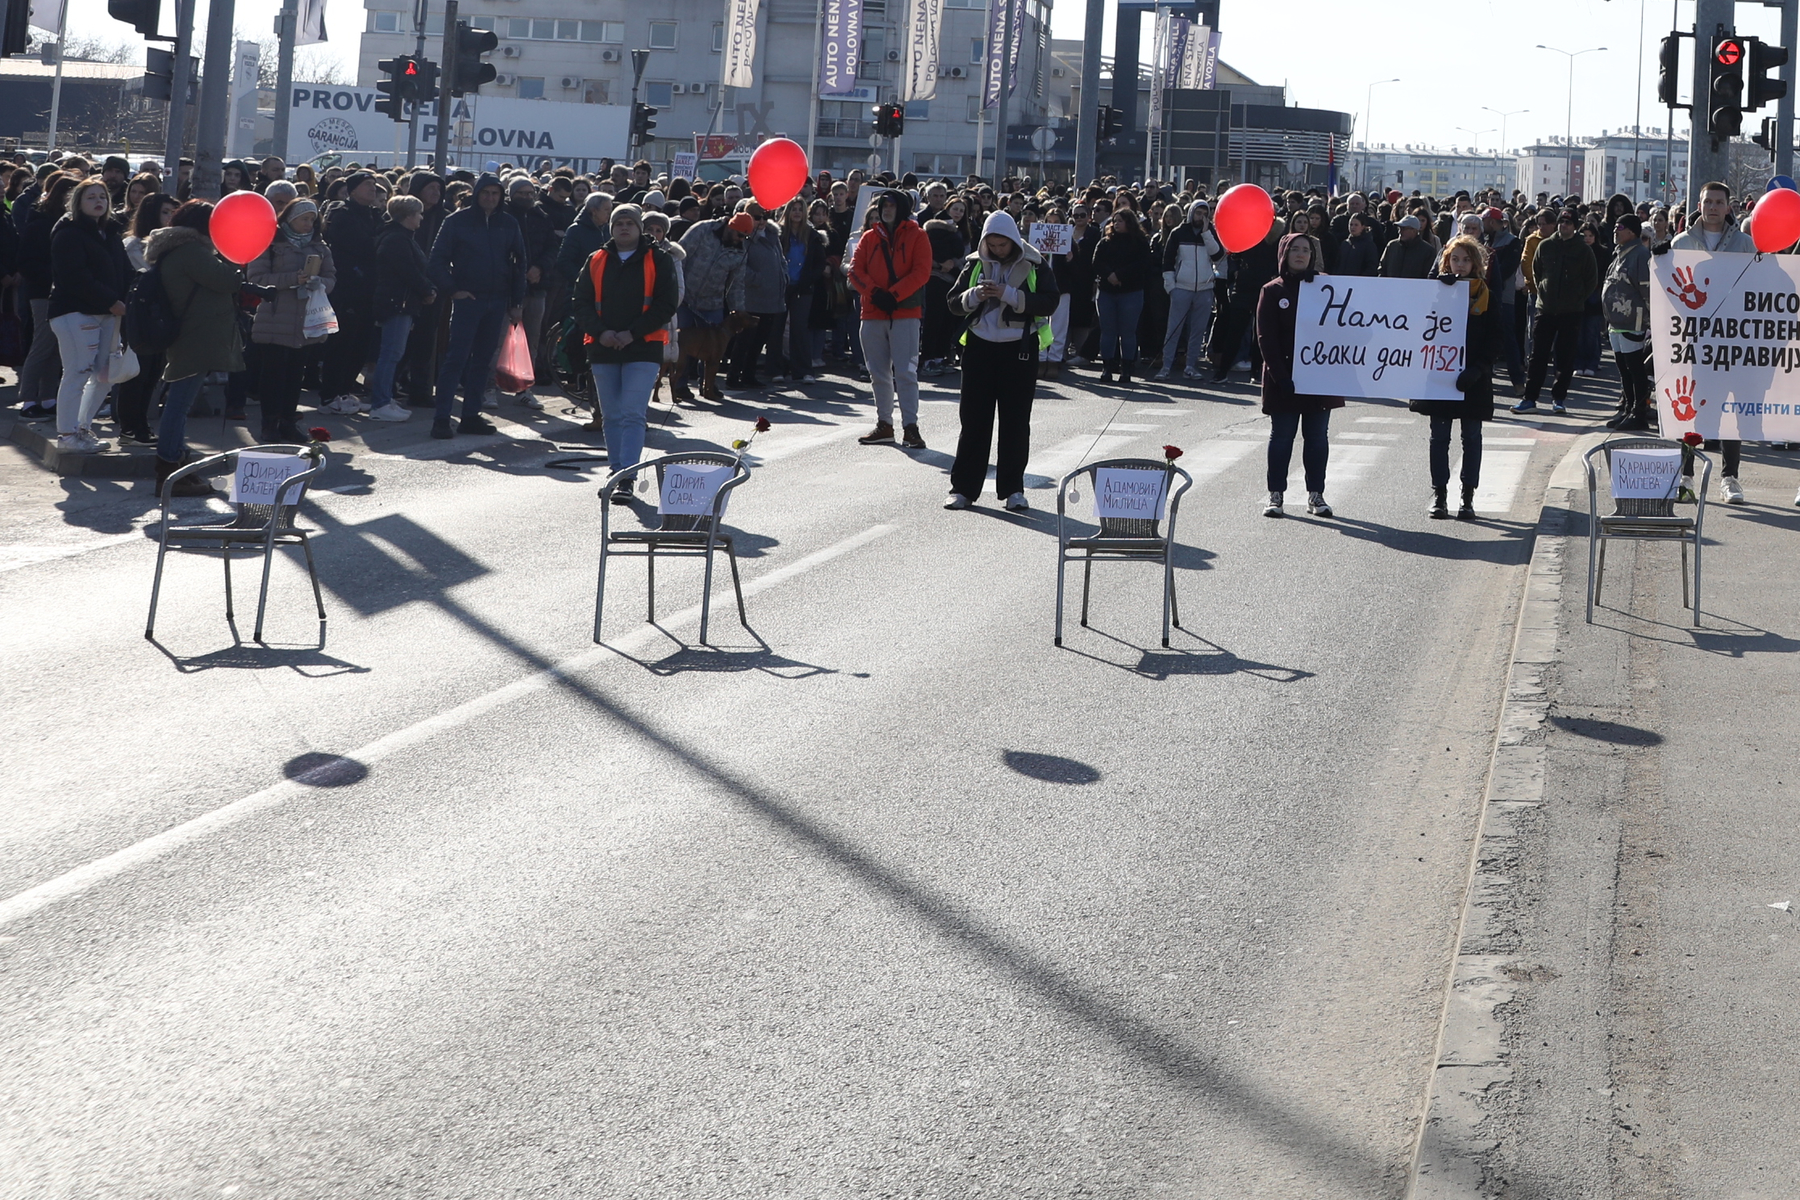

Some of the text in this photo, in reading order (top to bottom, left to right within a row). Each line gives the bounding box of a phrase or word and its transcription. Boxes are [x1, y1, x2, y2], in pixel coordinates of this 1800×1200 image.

[914, 1, 927, 46] NENA
[993, 11, 1007, 55] NENA
[845, 10, 859, 75] POLOVNA
[1171, 22, 1180, 53] STILL
[731, 31, 742, 79] AUTO
[826, 42, 839, 88] AUTO
[1183, 29, 1196, 89] ENA STILL
[1206, 46, 1217, 80] VOZILA
[912, 51, 923, 94] AUTO
[990, 60, 1001, 103] AUTO
[318, 120, 328, 130] 12
[308, 128, 359, 151] GARANCIJA
[673, 169, 693, 178] SUTRA
[1318, 284, 1453, 341] Нама је
[1300, 340, 1465, 381] сваки дан 11:52!
[1670, 343, 1697, 365] ЗА
[1721, 401, 1790, 417] СТУДЕНТИ
[243, 461, 291, 480] ФИРИЋ
[1618, 458, 1677, 475] КАРАНОВИЋ
[670, 473, 706, 490] ФИРИЋ
[1103, 477, 1157, 496] АДАМОВИЋ
[1619, 474, 1661, 490] МИЛЕВА
[667, 489, 694, 505] САРА
[1102, 493, 1149, 511] МИЛИЦА
